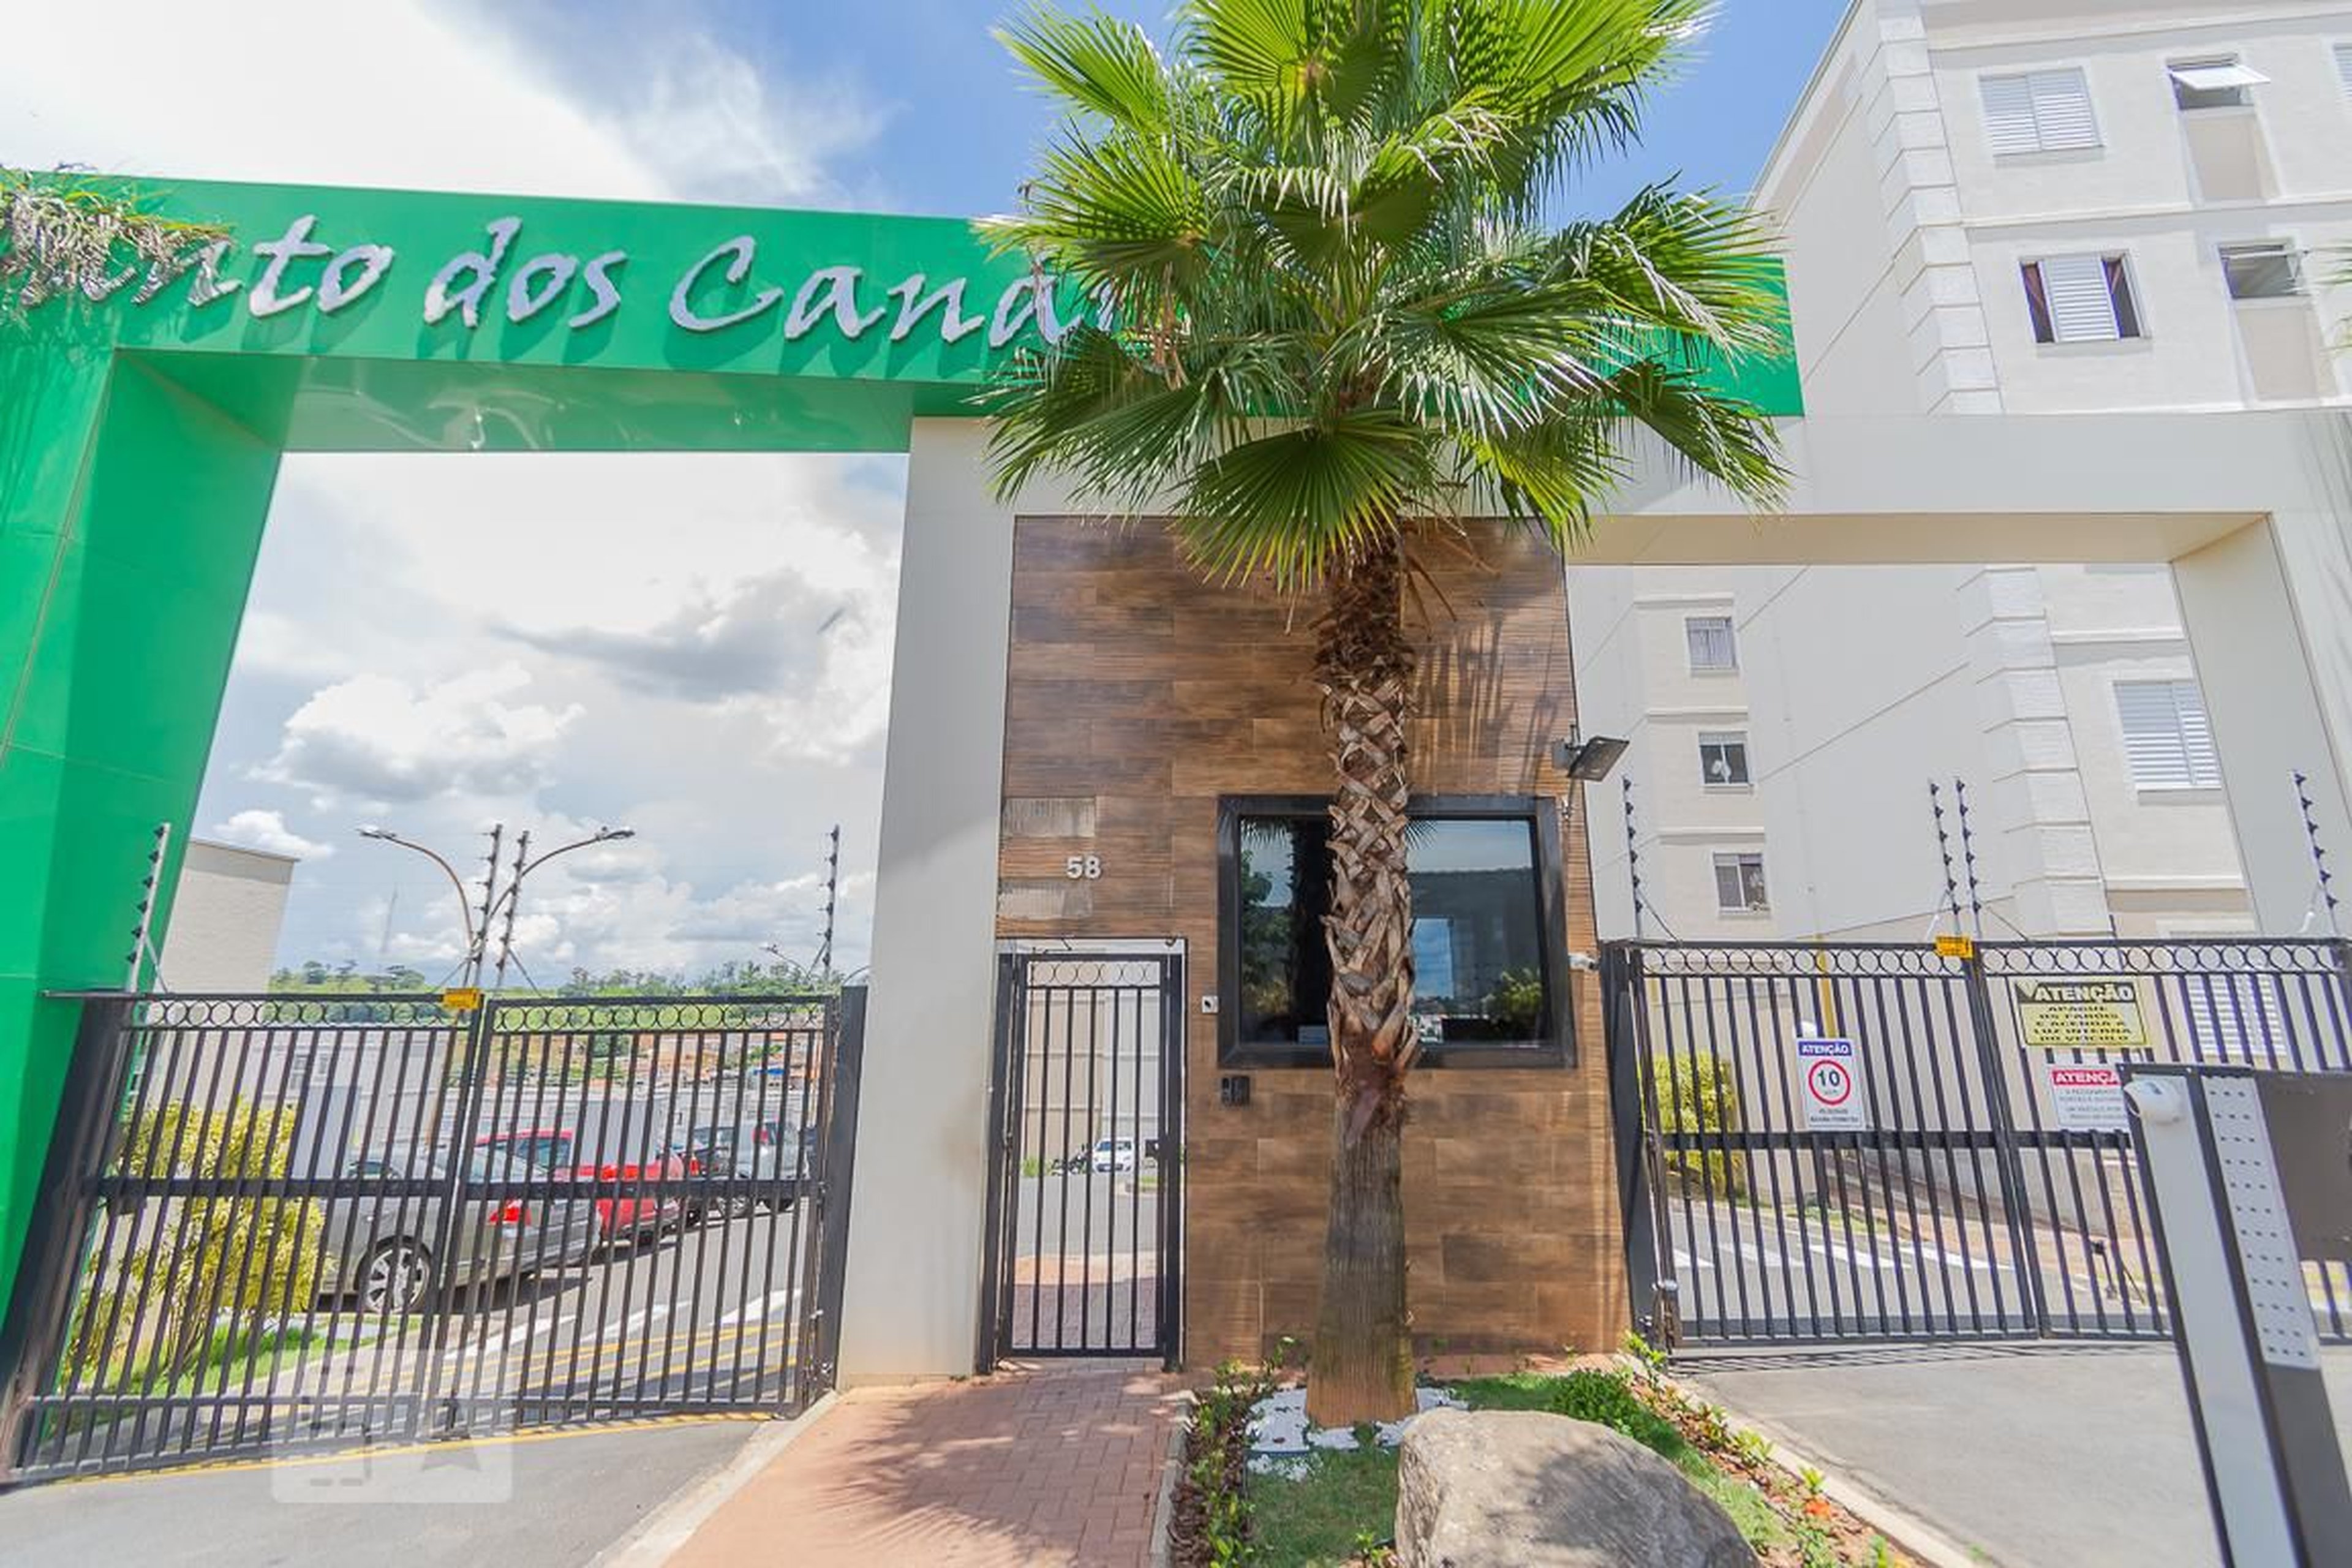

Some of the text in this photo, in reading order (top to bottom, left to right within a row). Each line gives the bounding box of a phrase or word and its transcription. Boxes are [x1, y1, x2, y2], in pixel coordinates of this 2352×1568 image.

[424, 216, 628, 327] dos
[1066, 856, 1101, 879] 58
[2034, 984, 2134, 1002] ATENÇÃO
[1802, 1042, 1849, 1054] ATENÇÃO
[1817, 1069, 1840, 1087] 10
